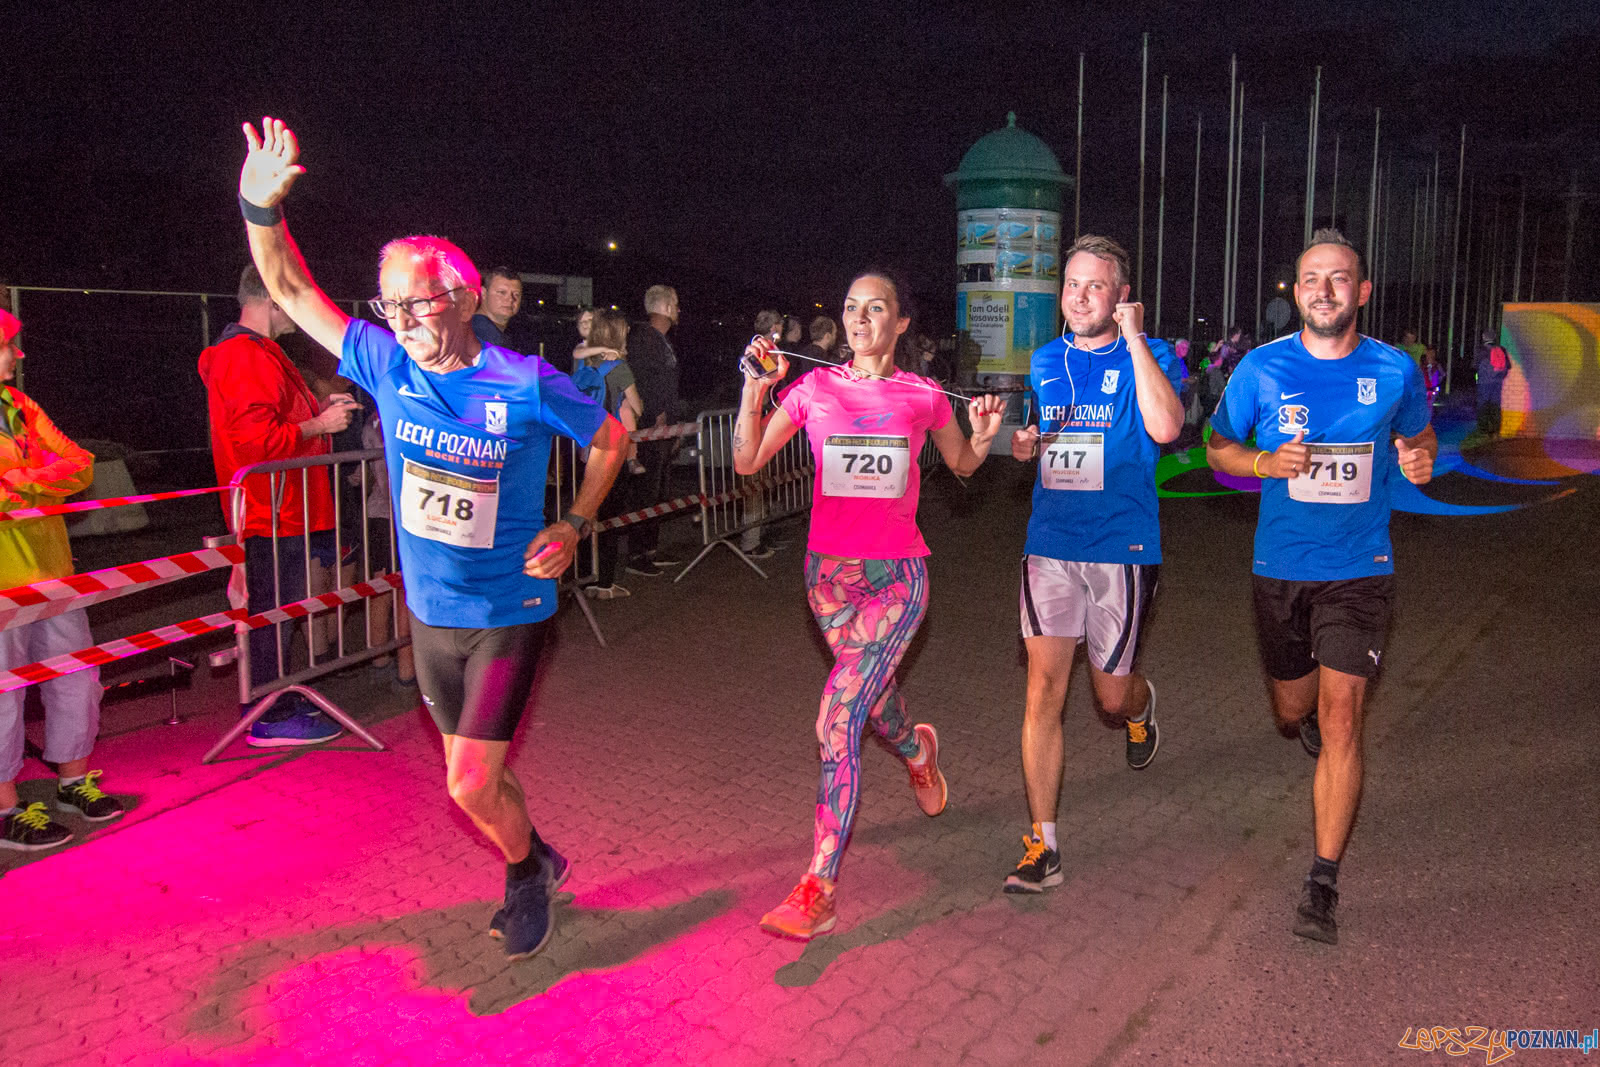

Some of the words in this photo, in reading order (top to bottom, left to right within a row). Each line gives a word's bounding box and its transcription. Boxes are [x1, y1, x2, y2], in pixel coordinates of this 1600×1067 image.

[969, 304, 984, 313] Tom
[986, 304, 1009, 313] Odell
[969, 313, 1010, 322] Nosowska
[1041, 405, 1065, 420] LECH
[1279, 406, 1308, 425] STS
[395, 419, 434, 448] LECH
[437, 431, 507, 460] POZNAŃ
[842, 454, 892, 474] 720
[1048, 450, 1087, 468] 717
[1309, 462, 1357, 480] 719
[418, 487, 473, 520] 718
